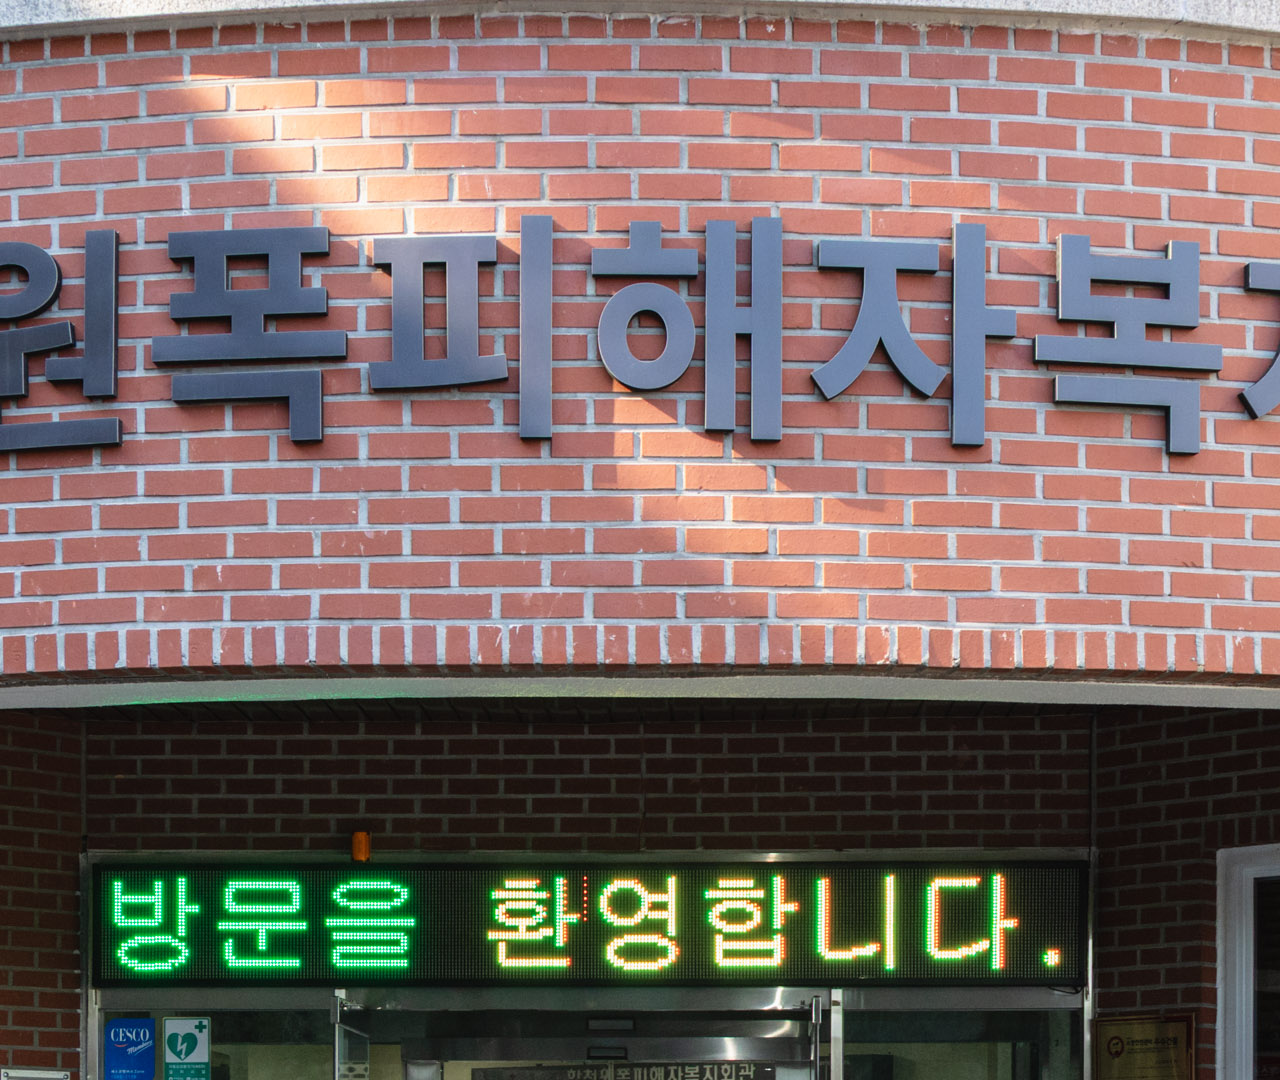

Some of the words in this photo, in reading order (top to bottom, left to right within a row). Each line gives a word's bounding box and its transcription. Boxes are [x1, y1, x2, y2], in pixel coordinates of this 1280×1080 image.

[112, 875, 416, 972] 방문을
[487, 873, 1063, 972] 환영합니다.
[110, 1027, 150, 1042] CESCO
